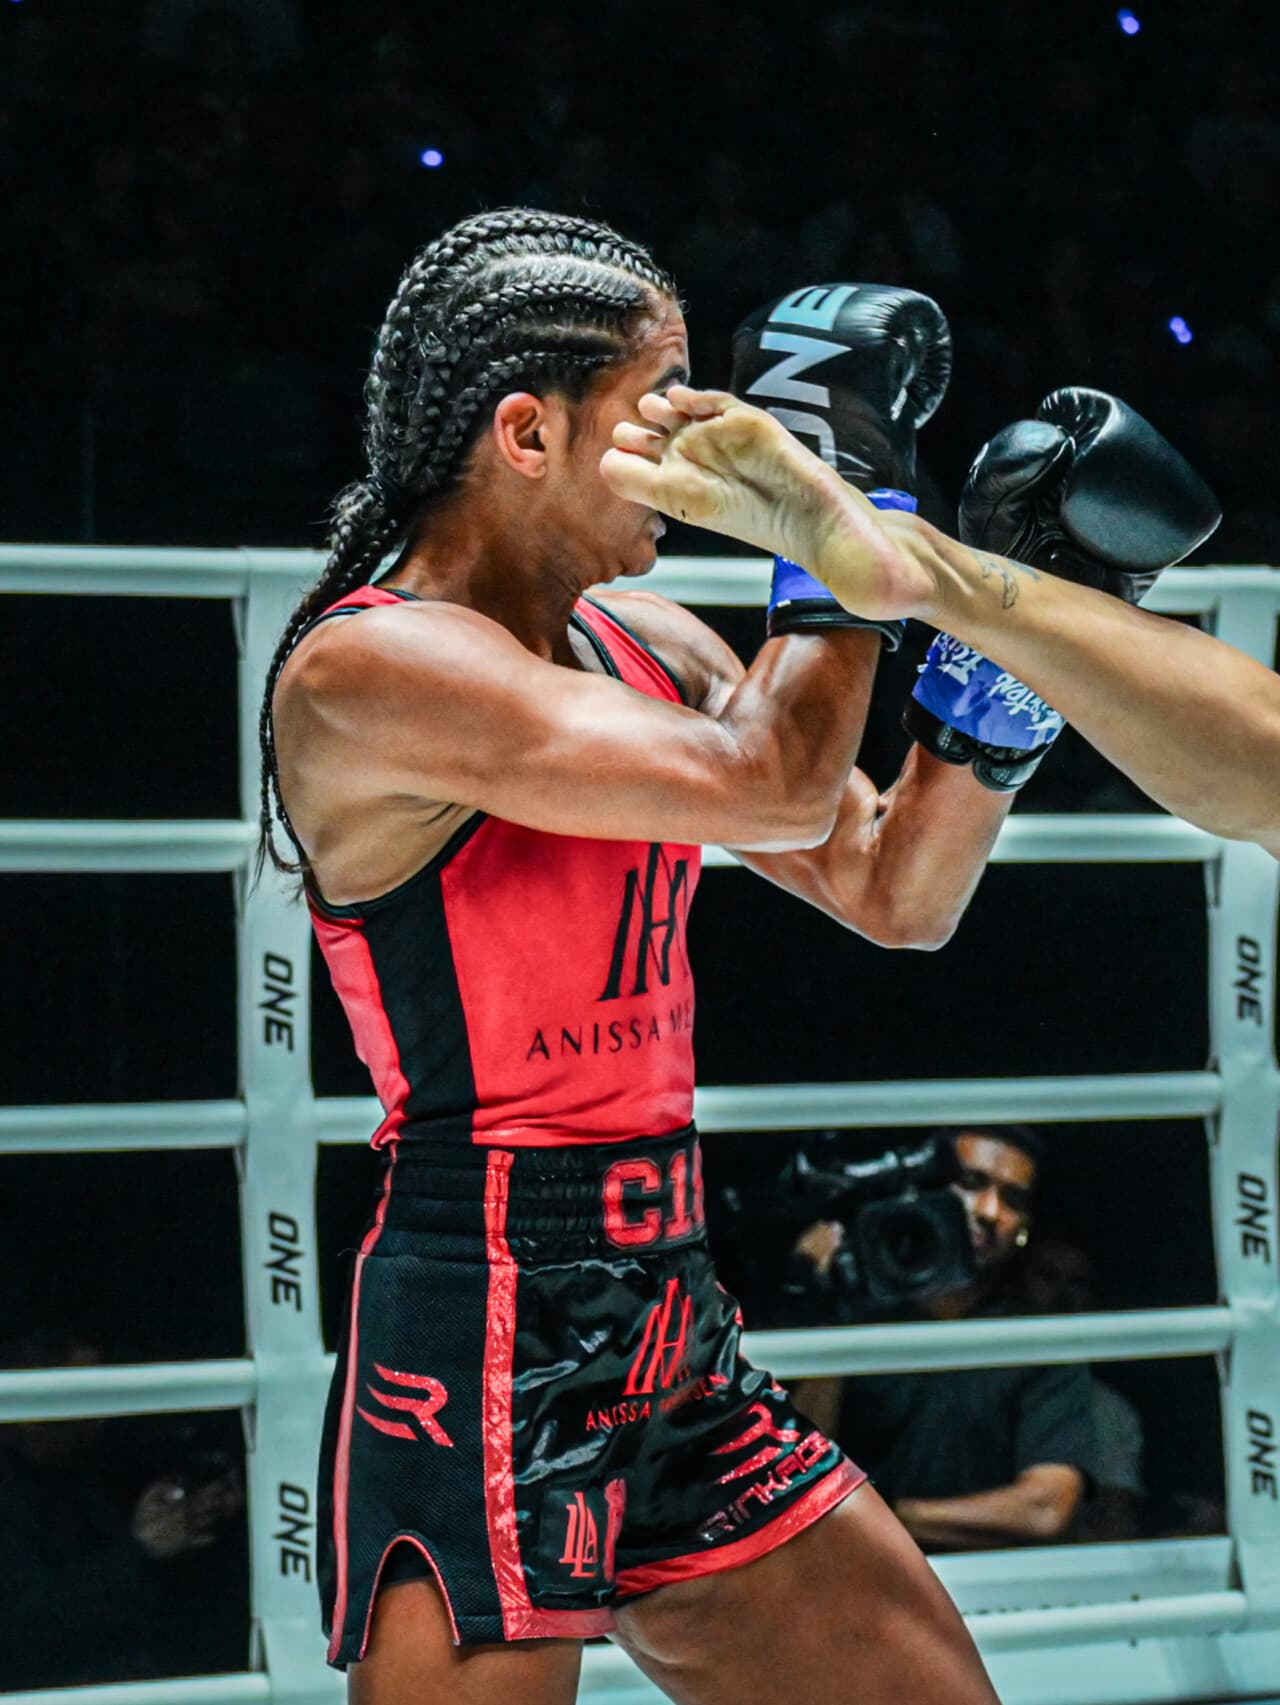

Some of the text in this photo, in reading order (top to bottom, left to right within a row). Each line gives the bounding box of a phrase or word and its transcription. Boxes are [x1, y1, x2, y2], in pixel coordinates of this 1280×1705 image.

[259, 951, 295, 1053] ONE
[1234, 935, 1263, 1027] ONE
[526, 1016, 660, 1062] ANISSA
[264, 1211, 304, 1314] ONE
[1235, 1172, 1270, 1264] ONE
[585, 1400, 652, 1431] ANISSA
[1247, 1409, 1278, 1501] ONE
[273, 1481, 312, 1583] ONE
